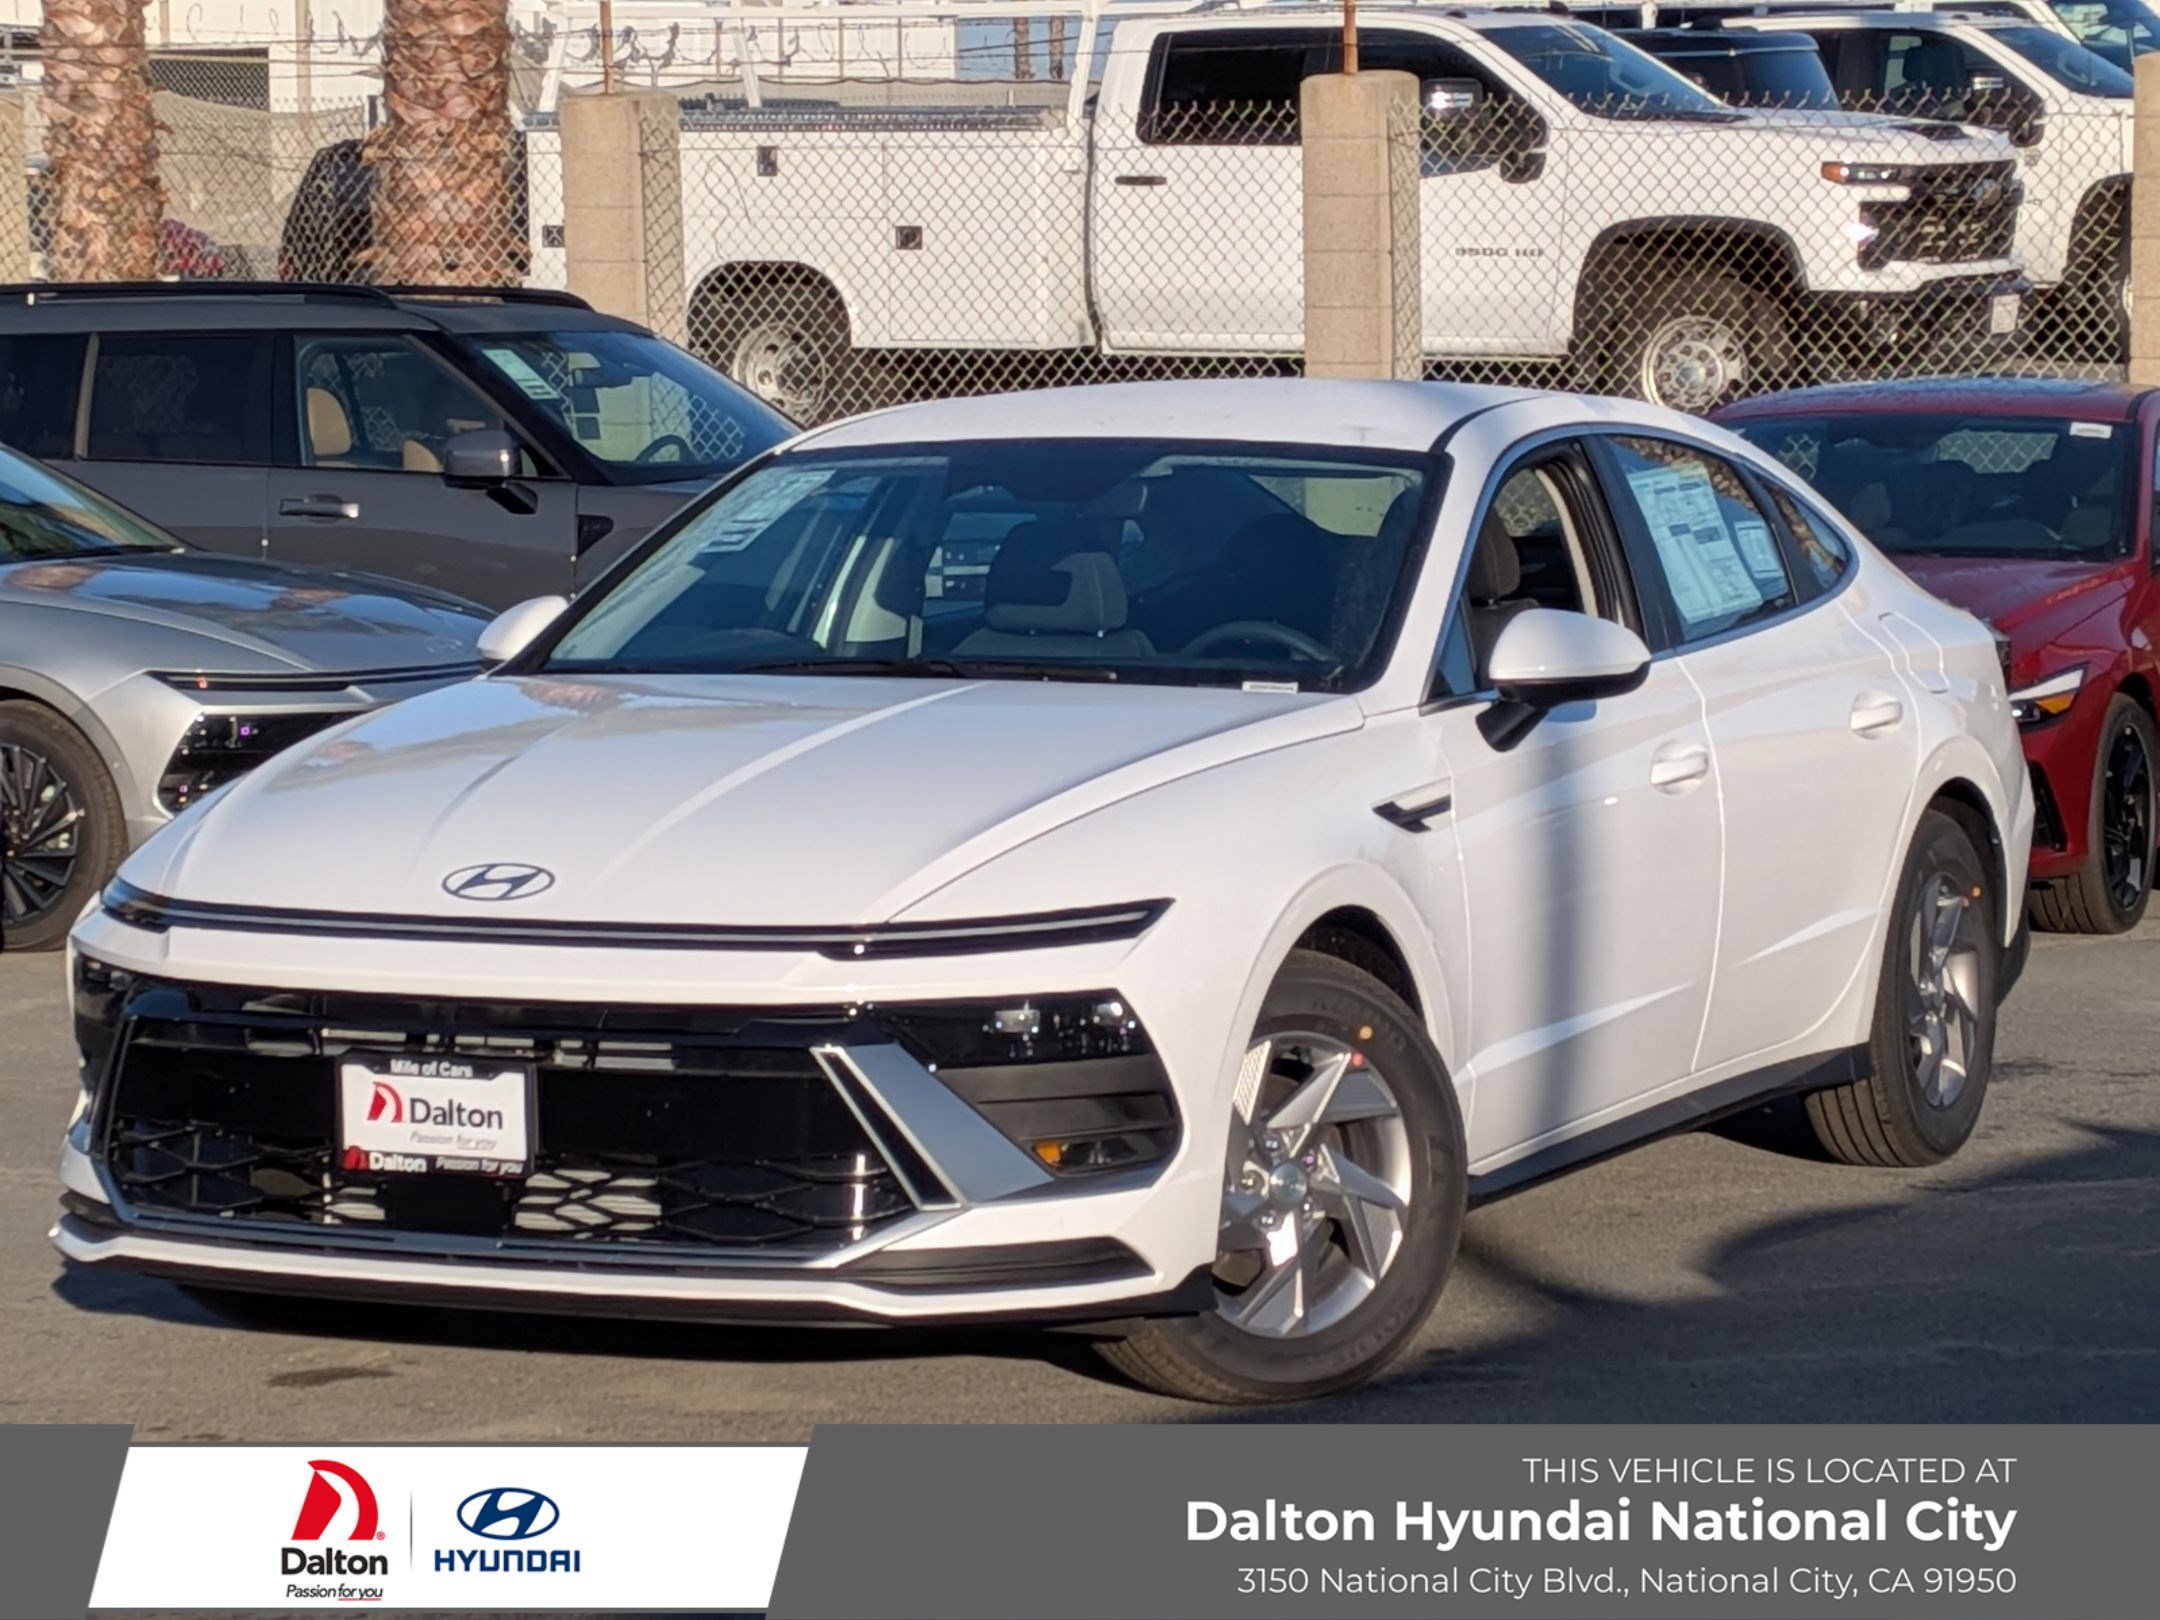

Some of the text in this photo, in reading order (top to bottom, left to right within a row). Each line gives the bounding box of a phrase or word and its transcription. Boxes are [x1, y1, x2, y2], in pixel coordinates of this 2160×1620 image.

[390, 1059, 473, 1077] Mile of Cars
[409, 1097, 503, 1129] Dalton
[369, 1152, 427, 1172] Dalton
